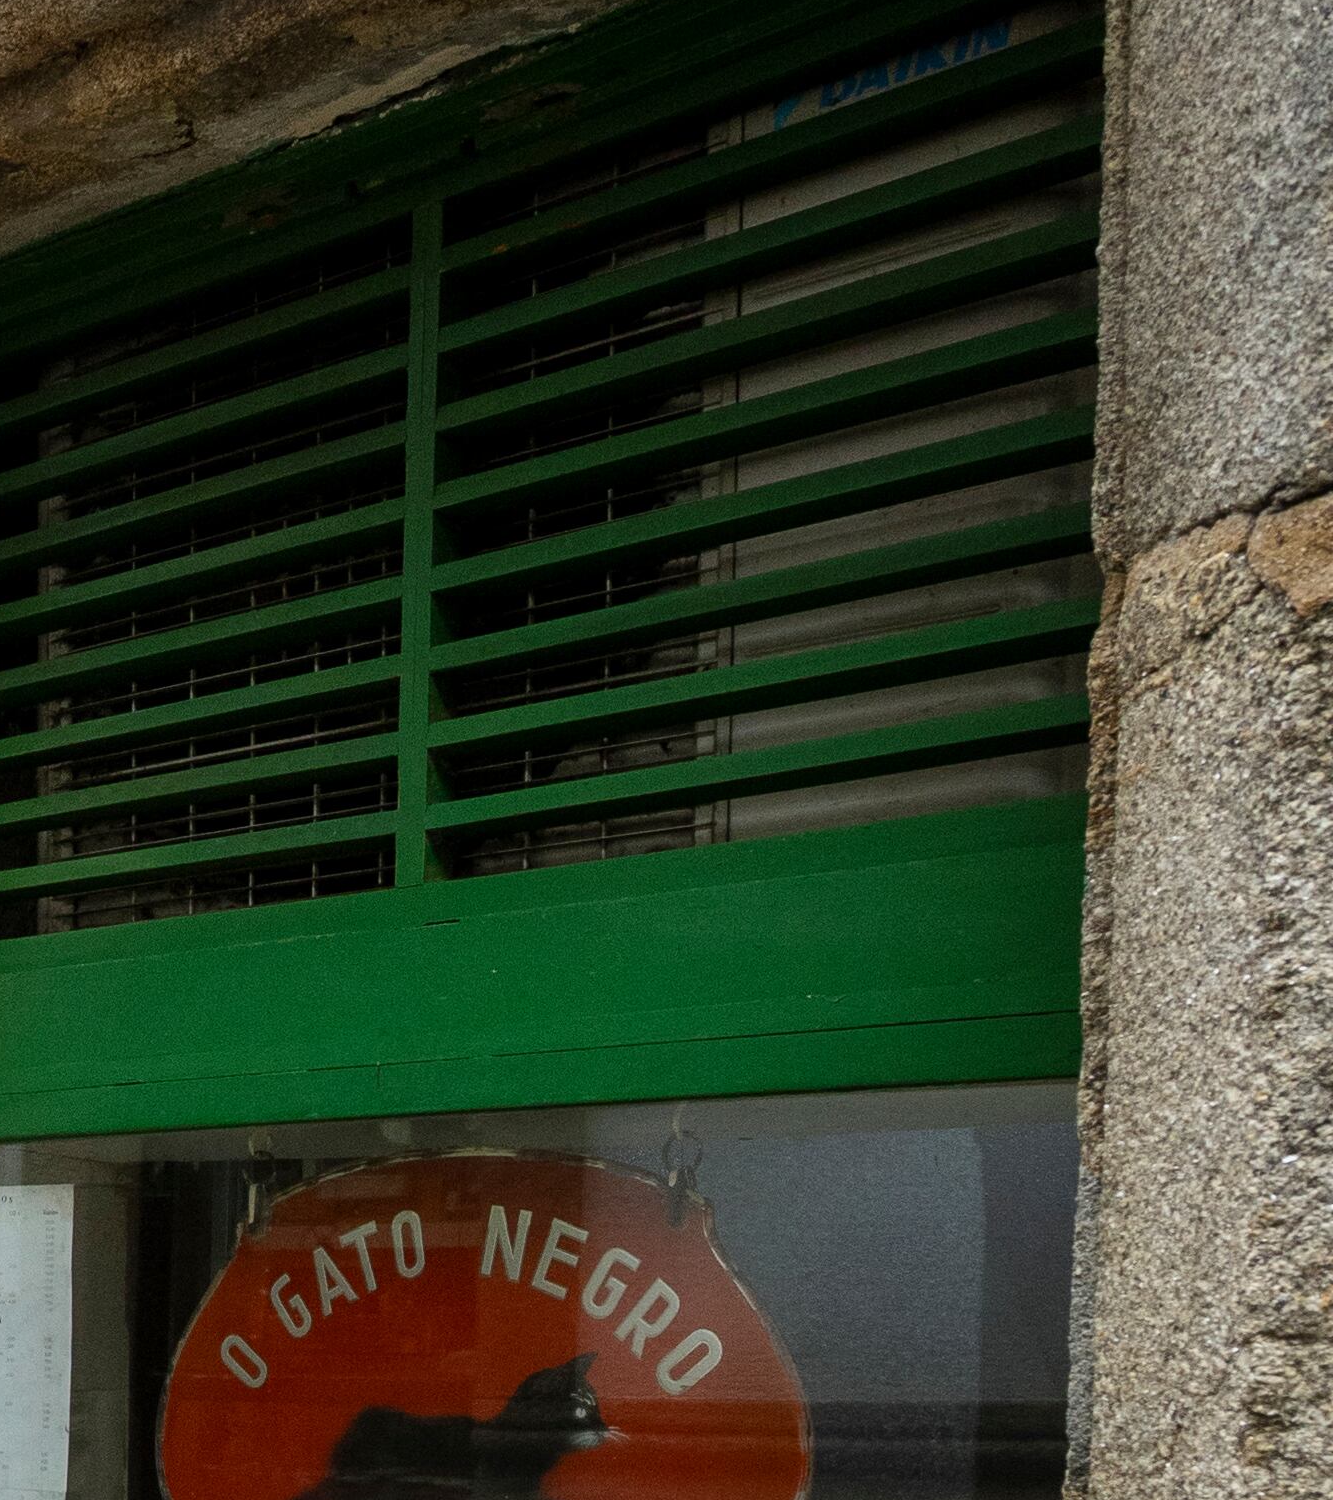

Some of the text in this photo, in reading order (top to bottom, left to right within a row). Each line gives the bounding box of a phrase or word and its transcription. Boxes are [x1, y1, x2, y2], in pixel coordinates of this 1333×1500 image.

[220, 1204, 723, 1395] O GATO NEGRO
